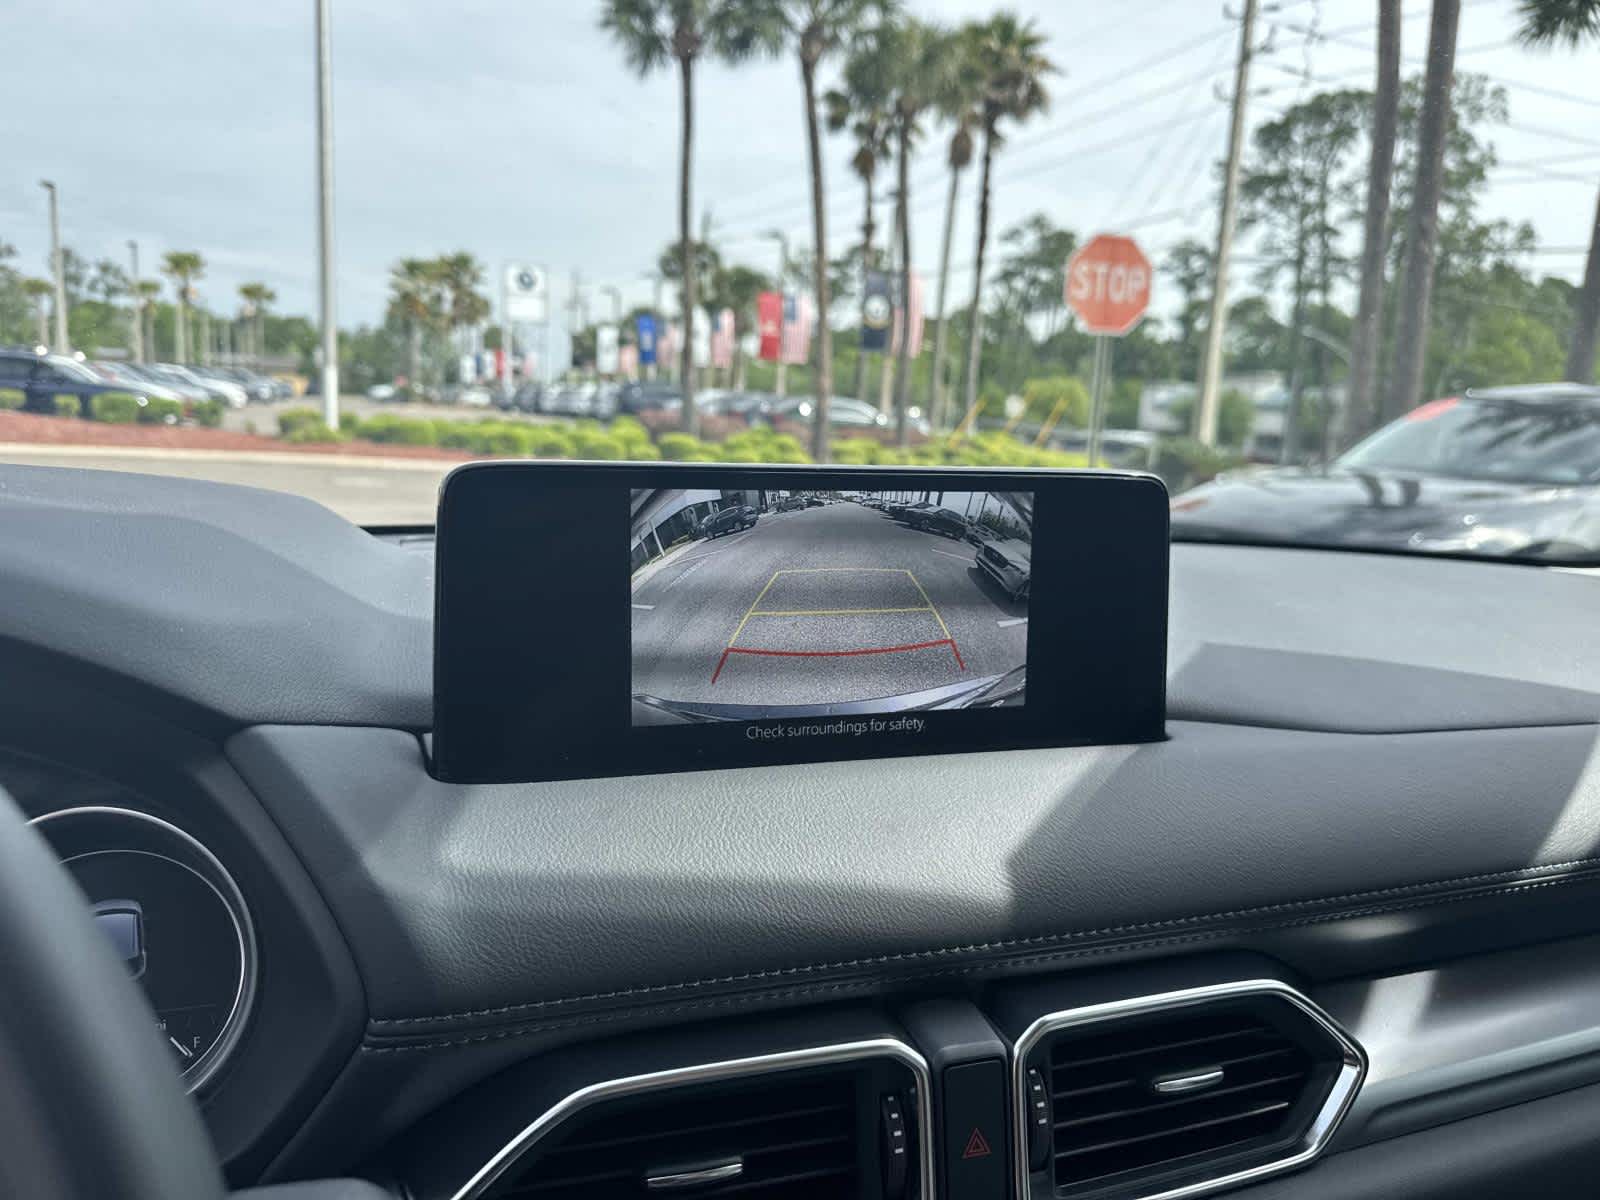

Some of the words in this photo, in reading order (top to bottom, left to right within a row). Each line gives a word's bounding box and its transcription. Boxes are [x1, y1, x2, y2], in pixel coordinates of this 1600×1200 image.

[1072, 263, 1145, 304] STOP
[746, 724, 785, 740] Check
[787, 719, 867, 736] surroundings
[870, 718, 886, 732] for
[193, 1036, 201, 1049] F
